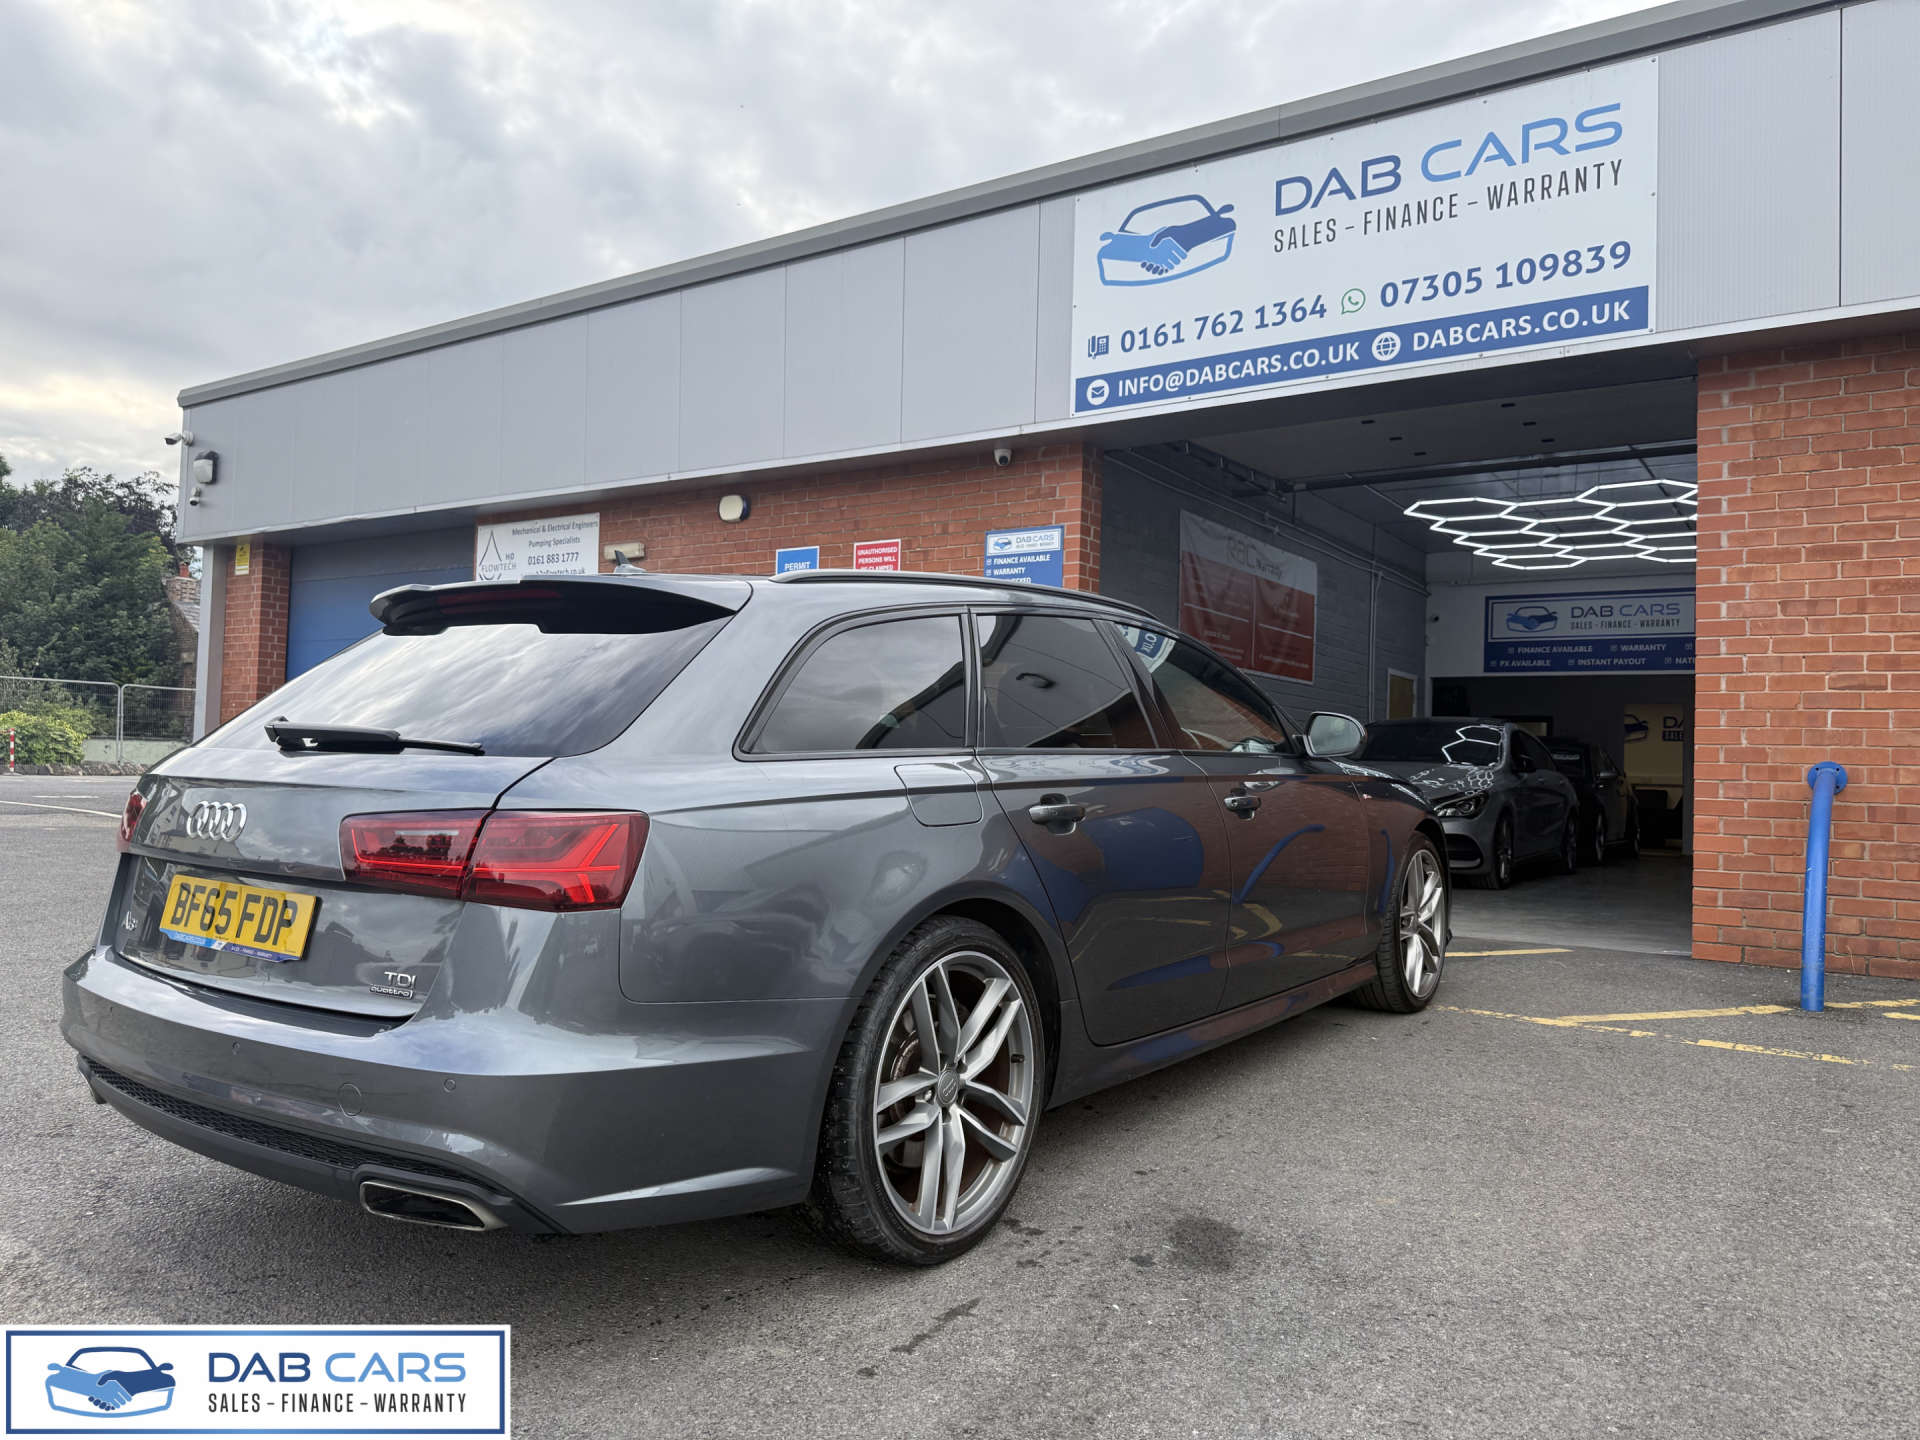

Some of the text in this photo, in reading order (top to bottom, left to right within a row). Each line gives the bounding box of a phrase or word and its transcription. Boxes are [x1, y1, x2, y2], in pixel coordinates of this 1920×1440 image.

[1275, 102, 1624, 217] DAB CARS
[1274, 218, 1337, 253] SALES
[1363, 193, 1459, 235] FINANCE
[1487, 159, 1623, 211] WARRANTY
[1120, 240, 1631, 353] 0161 762 1364 07305 109839
[1118, 300, 1631, 398] INFO@DABCARS.CO.UK DABCARS.CO.UK
[528, 555, 544, 565] 0161
[562, 552, 579, 562] 1777
[993, 554, 1051, 565] FINANCE AVAILABLE
[481, 562, 517, 573] FLOWTECH
[784, 561, 810, 571] PERMIT
[993, 567, 1025, 576] WARRANTY
[1571, 603, 1680, 618] DAB CARS
[1570, 621, 1592, 630] SALES
[1601, 620, 1631, 629] FINANCE
[1640, 618, 1680, 628] WARRANTY
[1517, 643, 1666, 654] FINANCE AVAILABLE WARRANTY
[1577, 658, 1611, 666] INSTANT
[1613, 657, 1646, 665] PAYOUT
[384, 971, 416, 988] TDI
[369, 985, 410, 998] quattro
